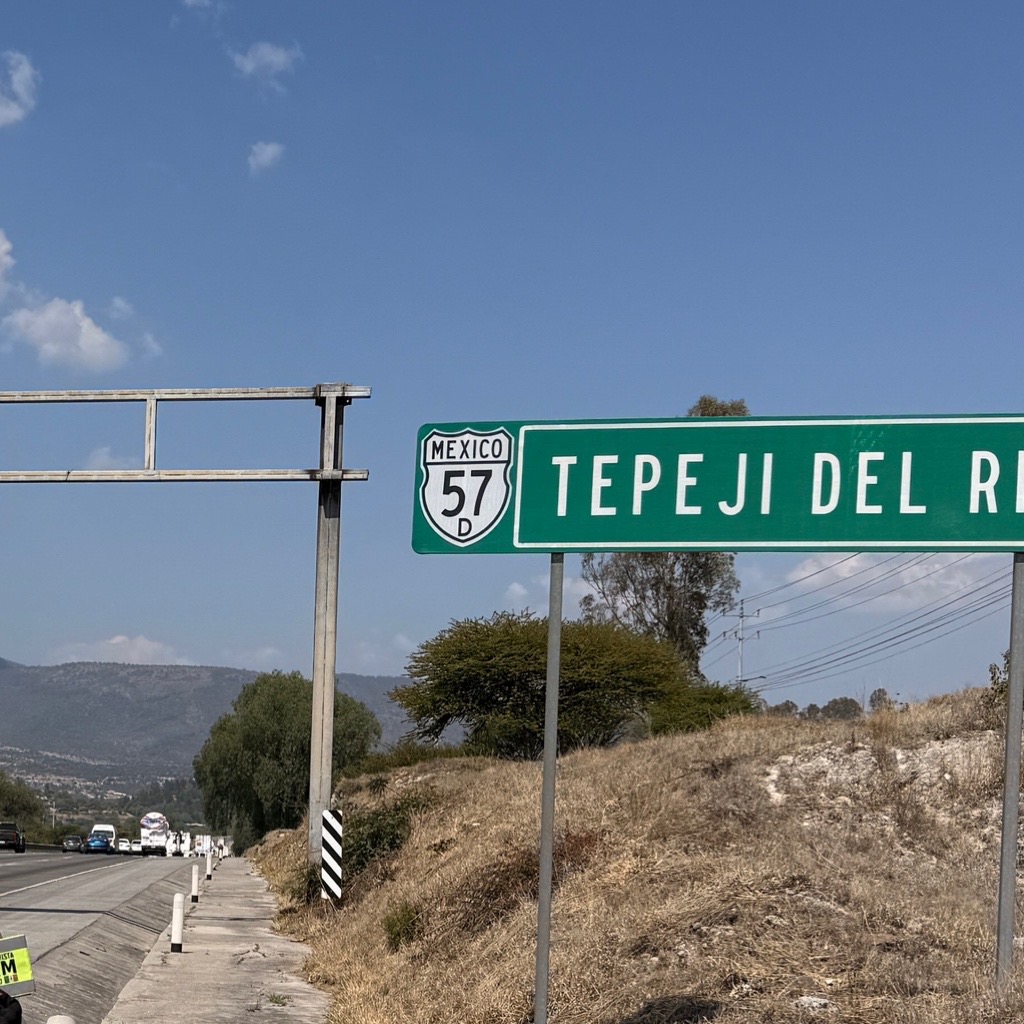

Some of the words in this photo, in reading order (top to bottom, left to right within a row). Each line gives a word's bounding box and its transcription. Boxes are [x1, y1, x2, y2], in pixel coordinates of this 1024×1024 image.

[432, 439, 502, 459] MEXICO
[442, 470, 492, 517] 57
[552, 453, 772, 516] TEPEJI
[812, 452, 926, 514] DEL
[458, 518, 472, 537] D
